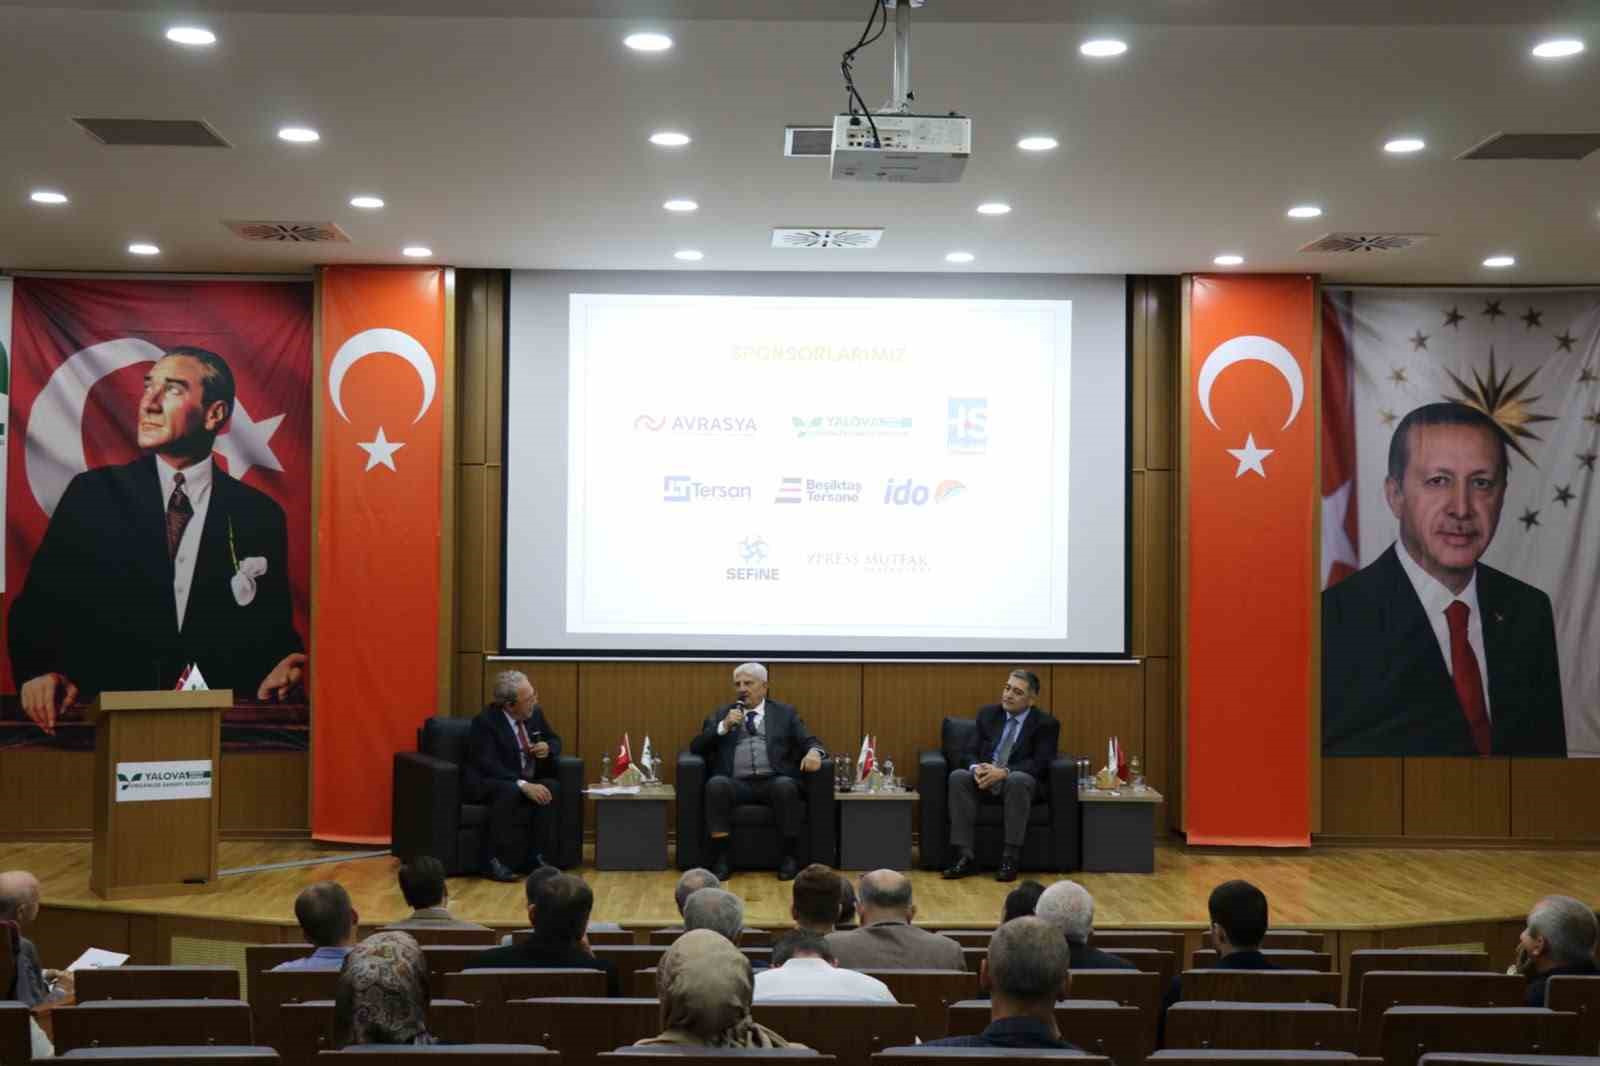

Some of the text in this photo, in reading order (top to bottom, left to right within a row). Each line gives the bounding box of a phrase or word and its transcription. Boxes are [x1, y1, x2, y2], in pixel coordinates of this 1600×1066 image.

[672, 416, 758, 432] AVRASYA
[691, 481, 751, 499] Tersan
[884, 478, 929, 505] ido
